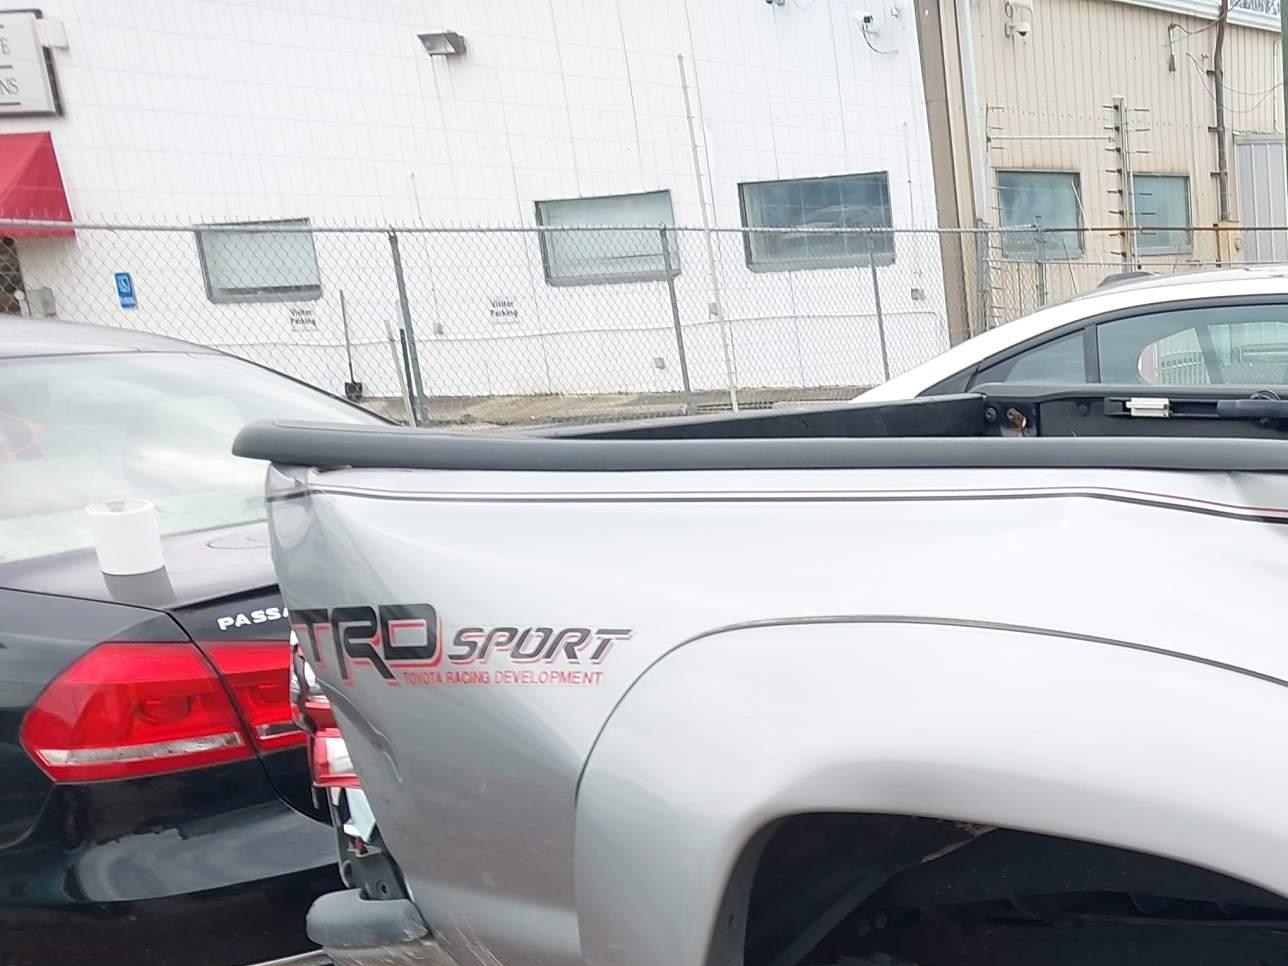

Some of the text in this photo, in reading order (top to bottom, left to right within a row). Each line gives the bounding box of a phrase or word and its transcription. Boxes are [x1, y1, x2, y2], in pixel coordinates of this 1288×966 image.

[290, 603, 633, 687] TRD SPORT
[402, 670, 604, 685] TOYOTA RACING DEVELOPMENT
